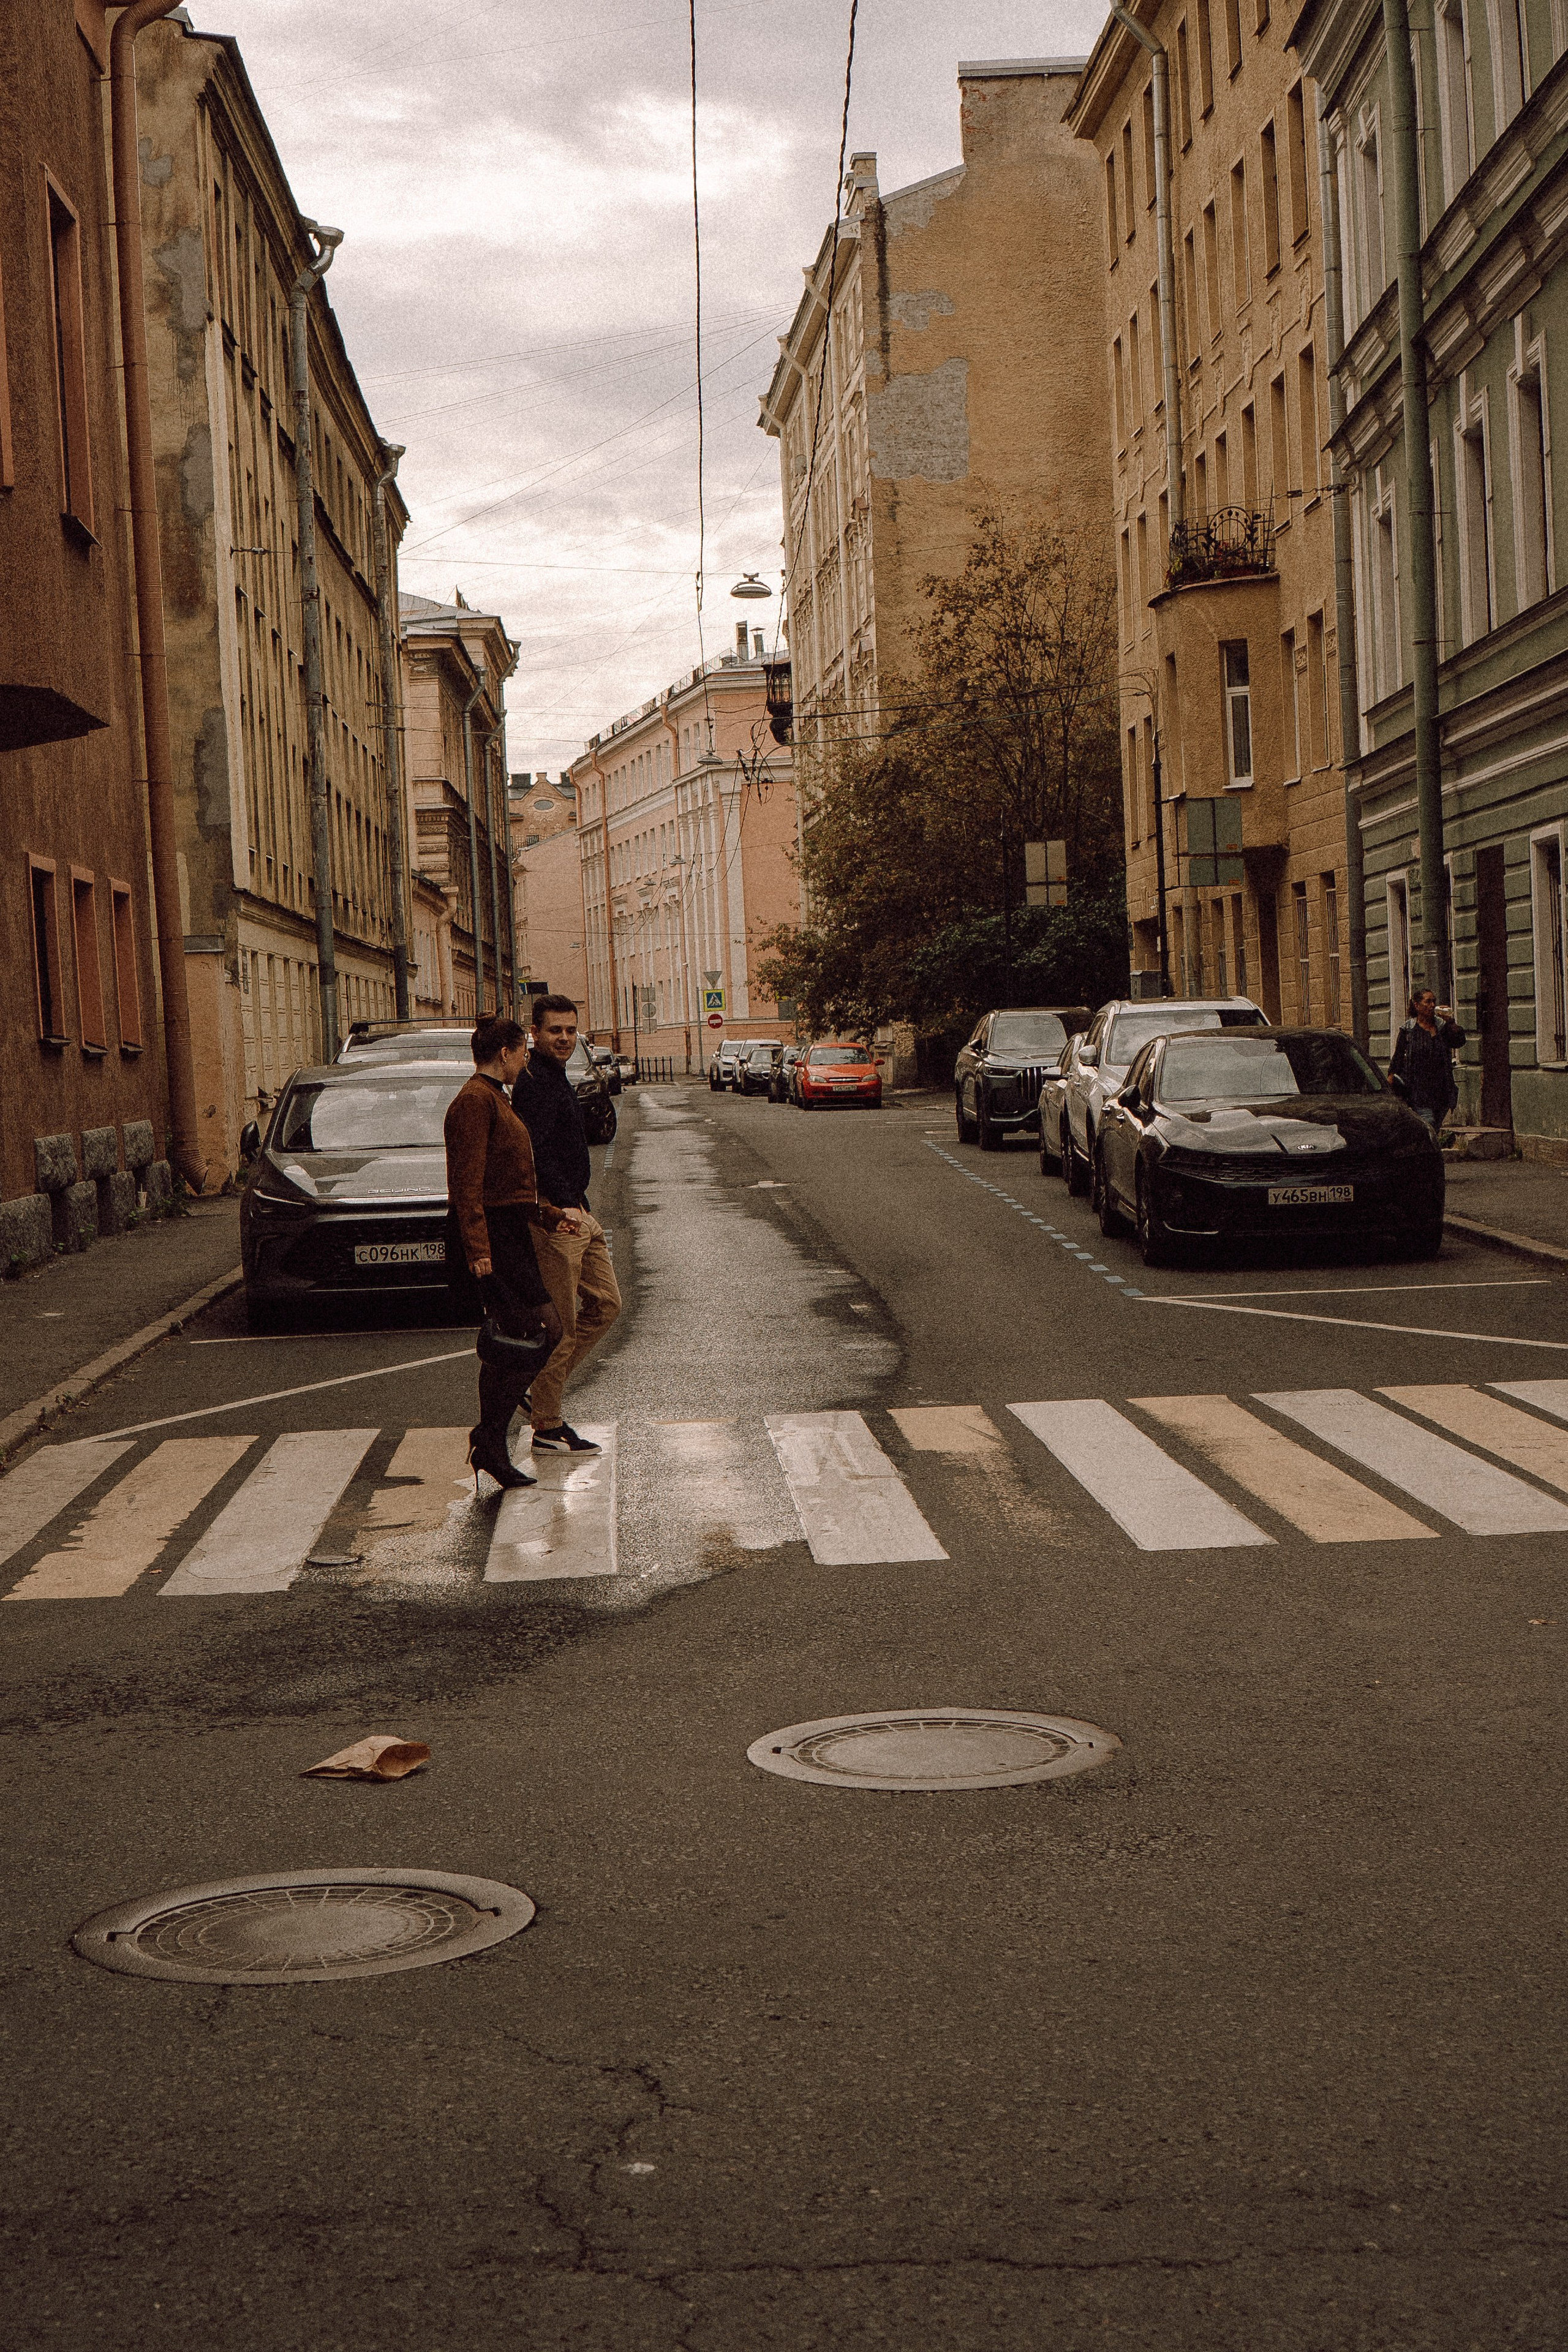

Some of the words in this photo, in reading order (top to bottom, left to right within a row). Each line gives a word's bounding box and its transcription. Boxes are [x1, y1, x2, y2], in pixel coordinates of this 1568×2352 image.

[1329, 1186, 1351, 1197] 198
[358, 1246, 420, 1262] С096НК
[422, 1243, 445, 1256] 198
